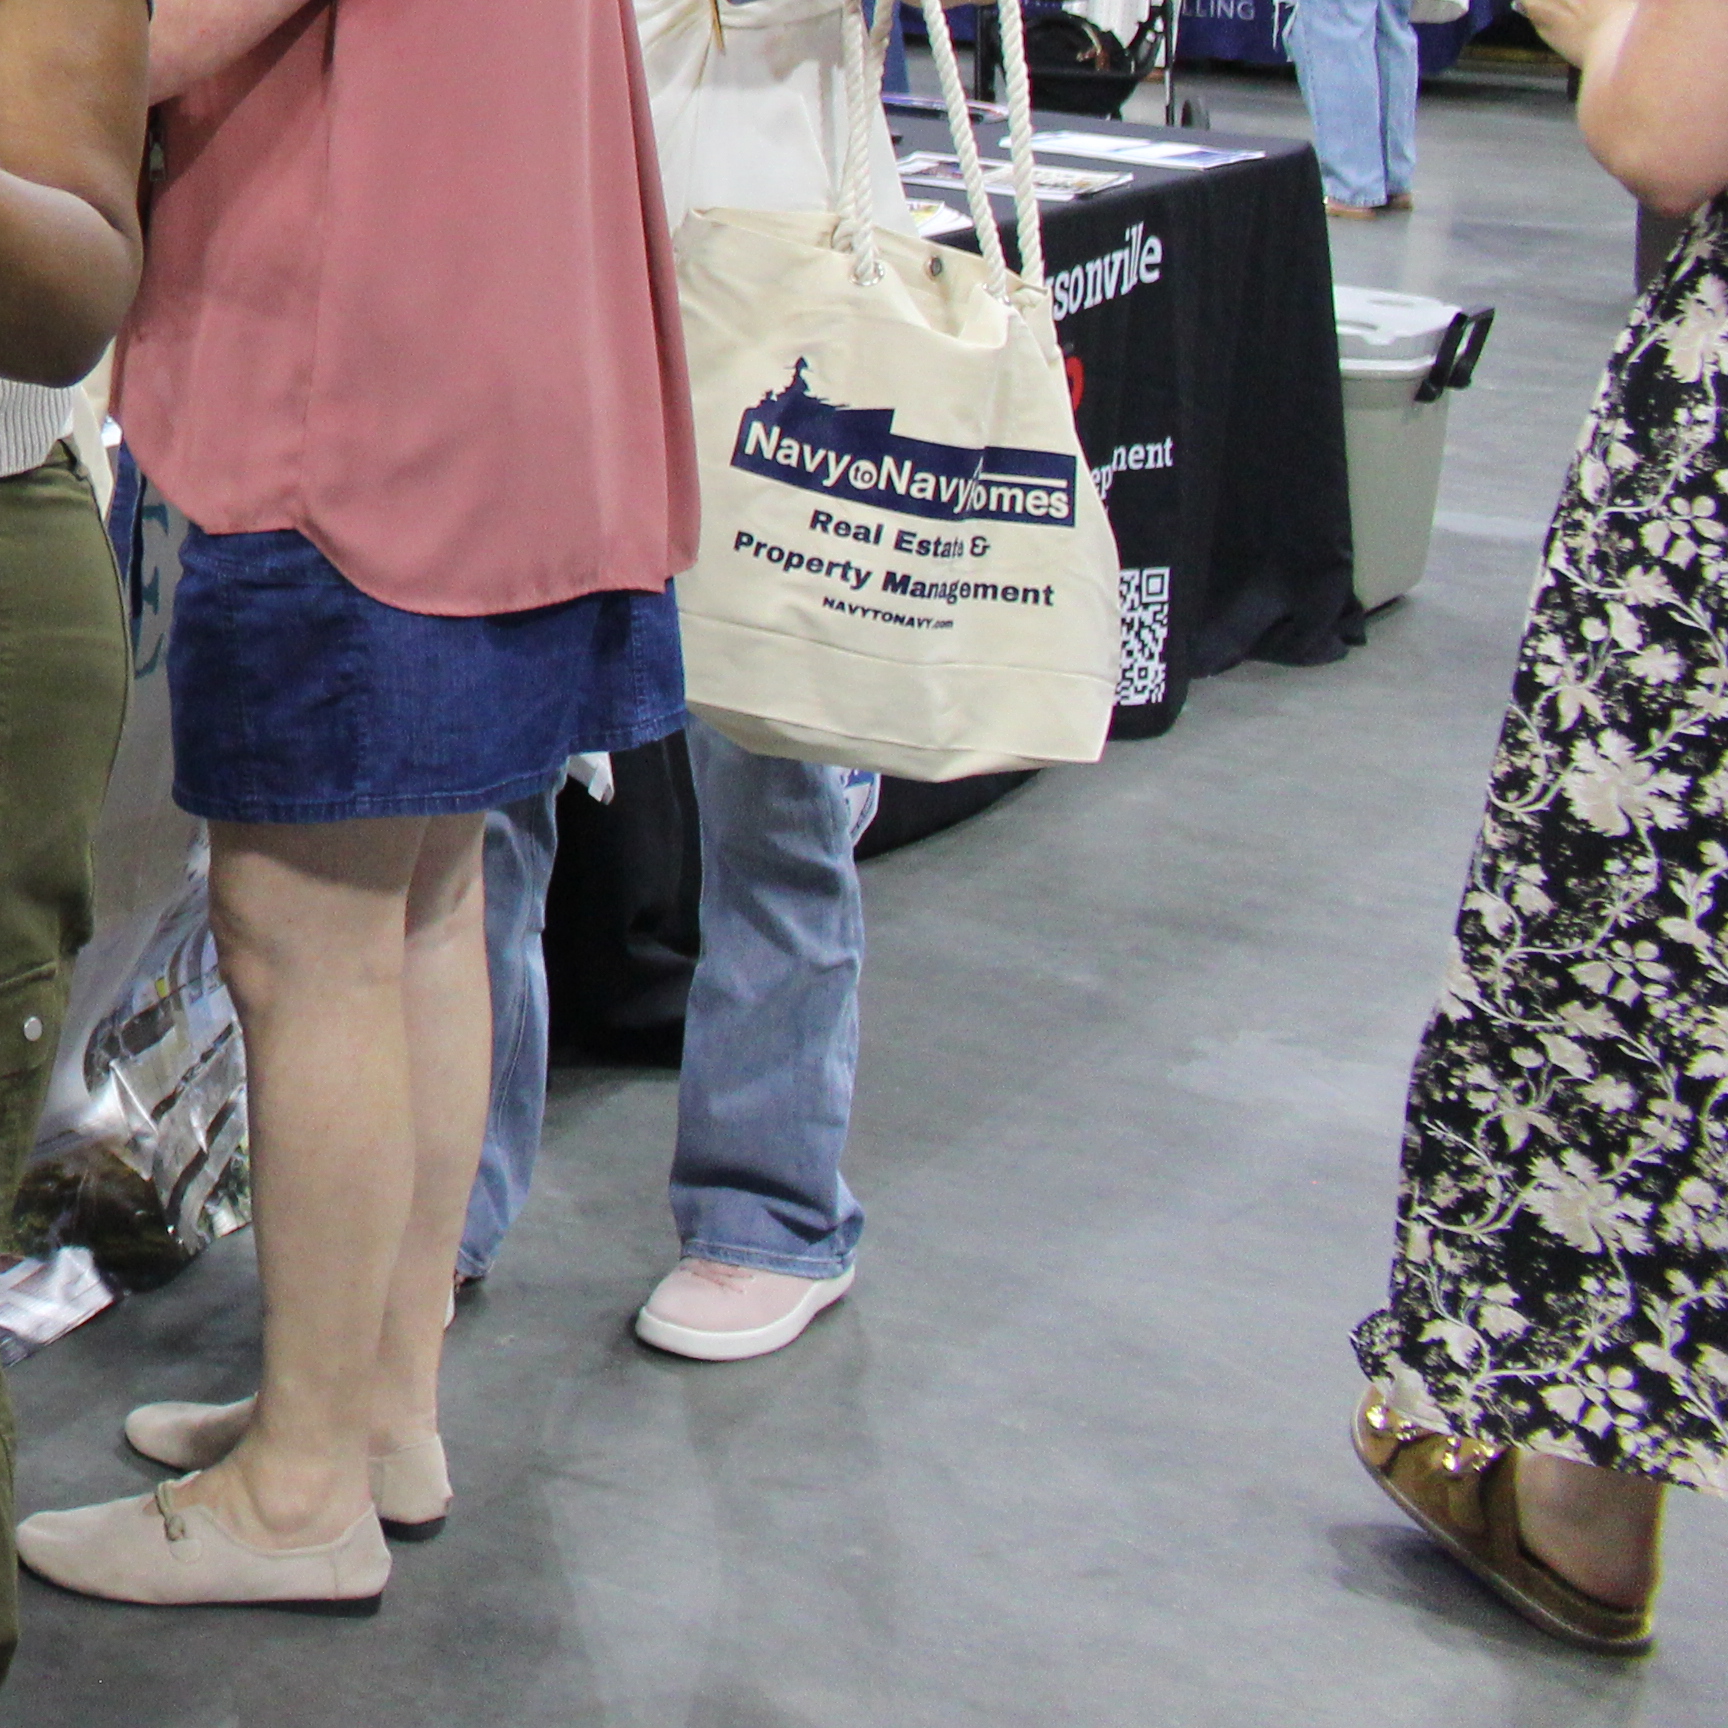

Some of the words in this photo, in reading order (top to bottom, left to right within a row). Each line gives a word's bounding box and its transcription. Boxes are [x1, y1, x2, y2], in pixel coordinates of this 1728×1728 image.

[808, 508, 885, 546] Real
[894, 529, 964, 559] Estate
[970, 535, 991, 557] &
[733, 529, 873, 591] Property
[882, 569, 1055, 607] Management
[822, 595, 954, 630] NAVYTONAVY.com
